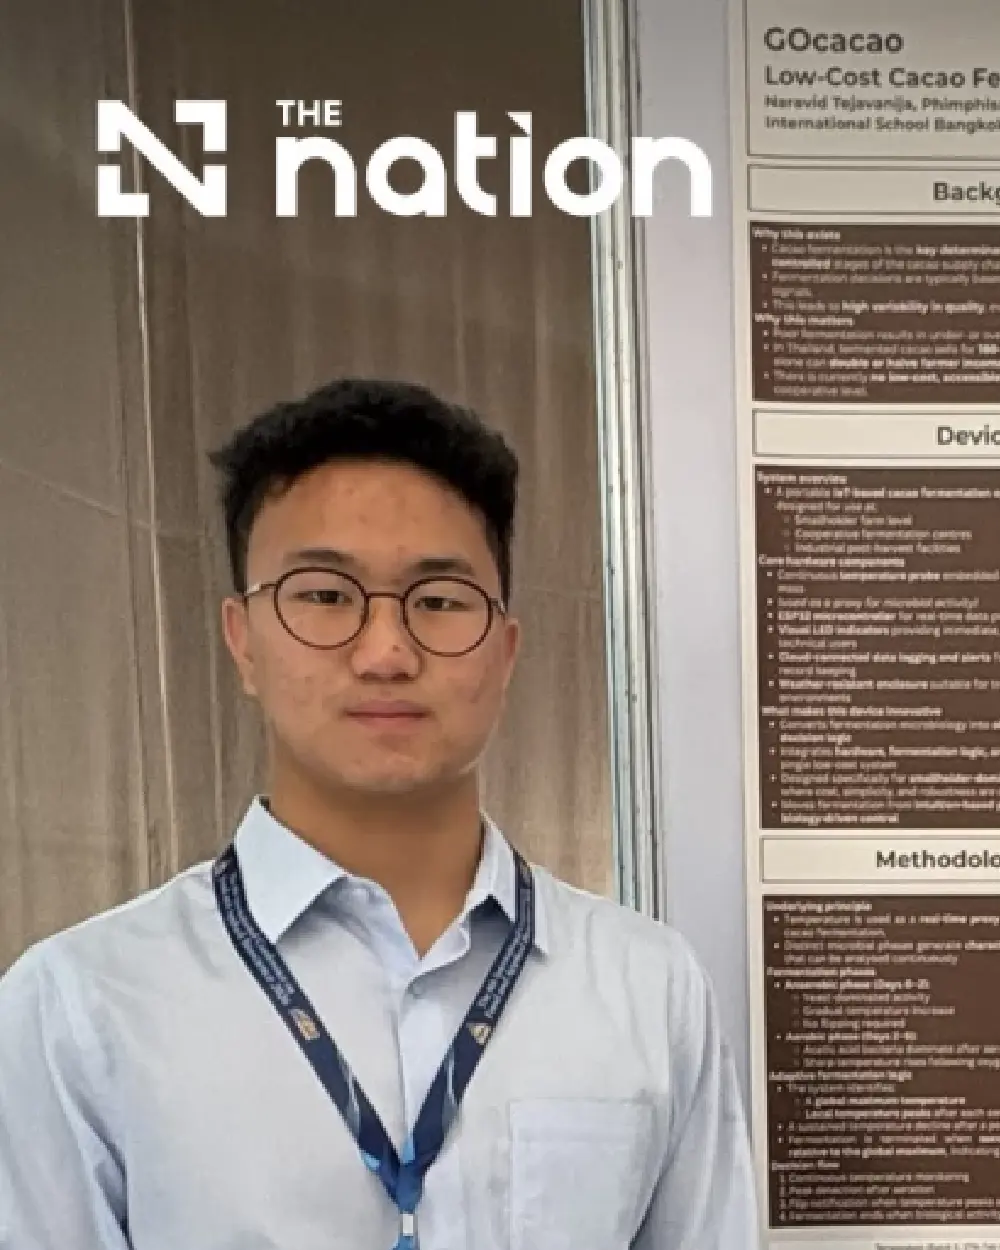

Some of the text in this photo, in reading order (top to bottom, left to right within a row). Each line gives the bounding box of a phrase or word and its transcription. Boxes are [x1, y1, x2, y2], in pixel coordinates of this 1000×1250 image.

[764, 27, 904, 53] GOcacao
[764, 65, 881, 87] Low-Cost
[889, 67, 967, 88] Cacao
[765, 95, 828, 110] Naravid
[833, 96, 917, 114] Tejavanija,
[765, 116, 871, 131] International
[876, 117, 930, 131] School
